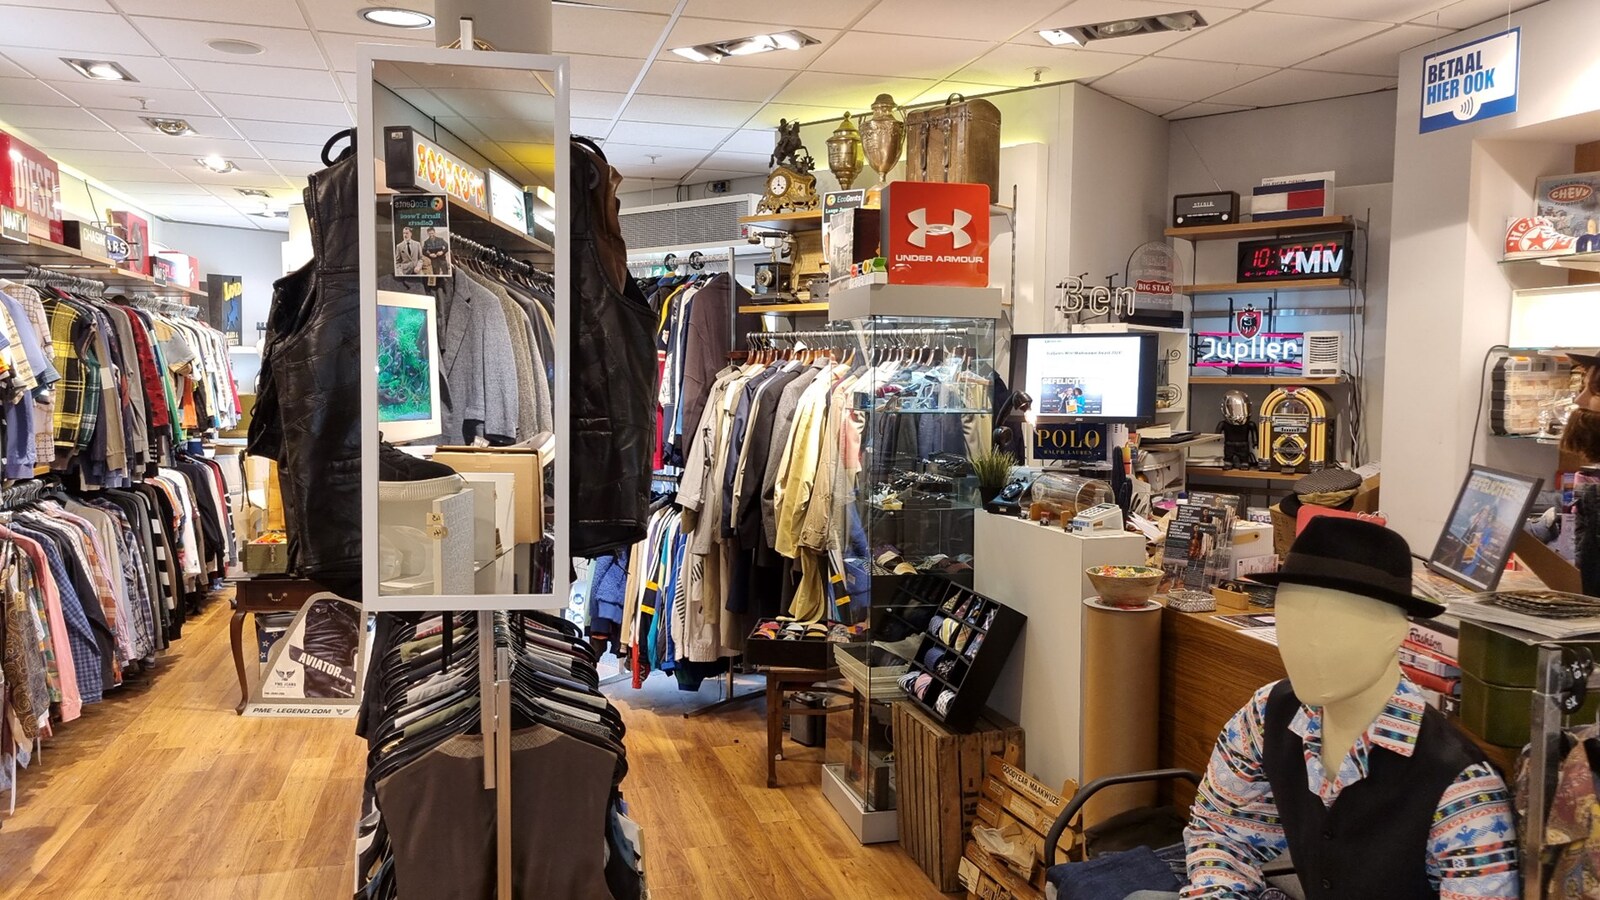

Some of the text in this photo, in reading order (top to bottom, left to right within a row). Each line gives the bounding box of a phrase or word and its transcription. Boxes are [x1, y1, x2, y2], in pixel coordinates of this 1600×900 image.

[1428, 50, 1483, 85] BETAAL
[1427, 68, 1495, 105] HIER OOK
[13, 156, 63, 223] DIESEL
[837, 194, 862, 204] EcoGents
[1551, 187, 1589, 199] CHEVY
[895, 254, 983, 263] UNDER ARMOUR
[1060, 275, 1136, 316] Ben
[1138, 283, 1171, 292] BIG STAR
[1037, 429, 1101, 449] POLO
[1409, 627, 1444, 653] Fashion
[298, 652, 342, 679] AVIATOR
[1001, 763, 1029, 786] GOODYEAR
